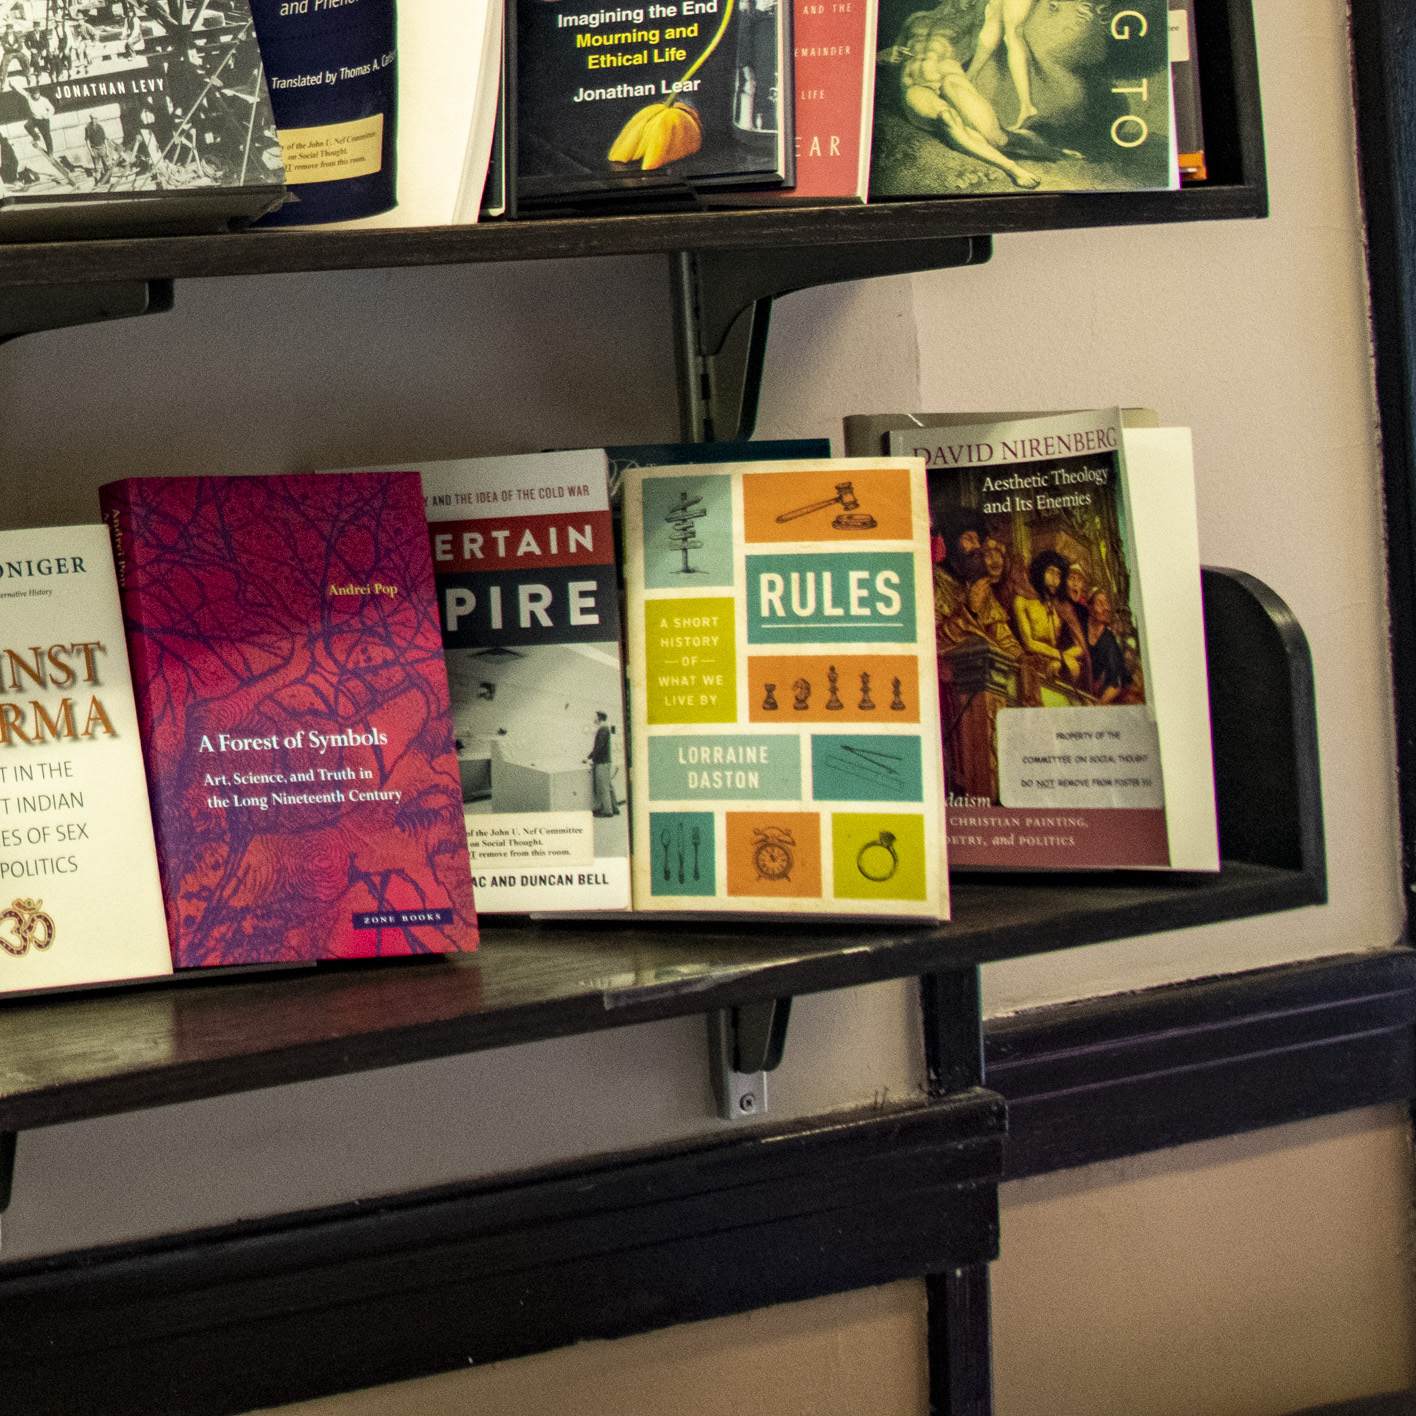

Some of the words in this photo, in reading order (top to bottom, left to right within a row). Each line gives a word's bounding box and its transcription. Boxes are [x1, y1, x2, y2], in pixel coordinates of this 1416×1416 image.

[557, 5, 645, 29] Imagining
[649, 4, 678, 20] the
[682, 0, 719, 16] End
[576, 28, 661, 49] Mourning
[664, 23, 699, 41] and
[588, 49, 649, 70] Ethical
[653, 46, 687, 63] Life
[55, 80, 127, 100] JONATHAN
[131, 77, 166, 94] LEVY
[1110, 78, 1149, 148] TO
[1001, 426, 1119, 462] NIRENBERG
[982, 472, 1049, 493] Aesthetic
[1052, 465, 1109, 489] Theology
[983, 497, 1011, 515] and
[1015, 496, 1033, 512] Its
[1036, 490, 1092, 510] Enemies
[759, 570, 903, 618] RULES
[199, 735, 215, 754] A
[219, 733, 282, 752] Forest
[286, 731, 306, 750] of
[308, 728, 388, 759] Symbols
[678, 745, 769, 765] LORRAINE
[687, 771, 759, 790] DASTON
[521, 873, 574, 888] DUNCAN
[577, 873, 609, 886] BELL
